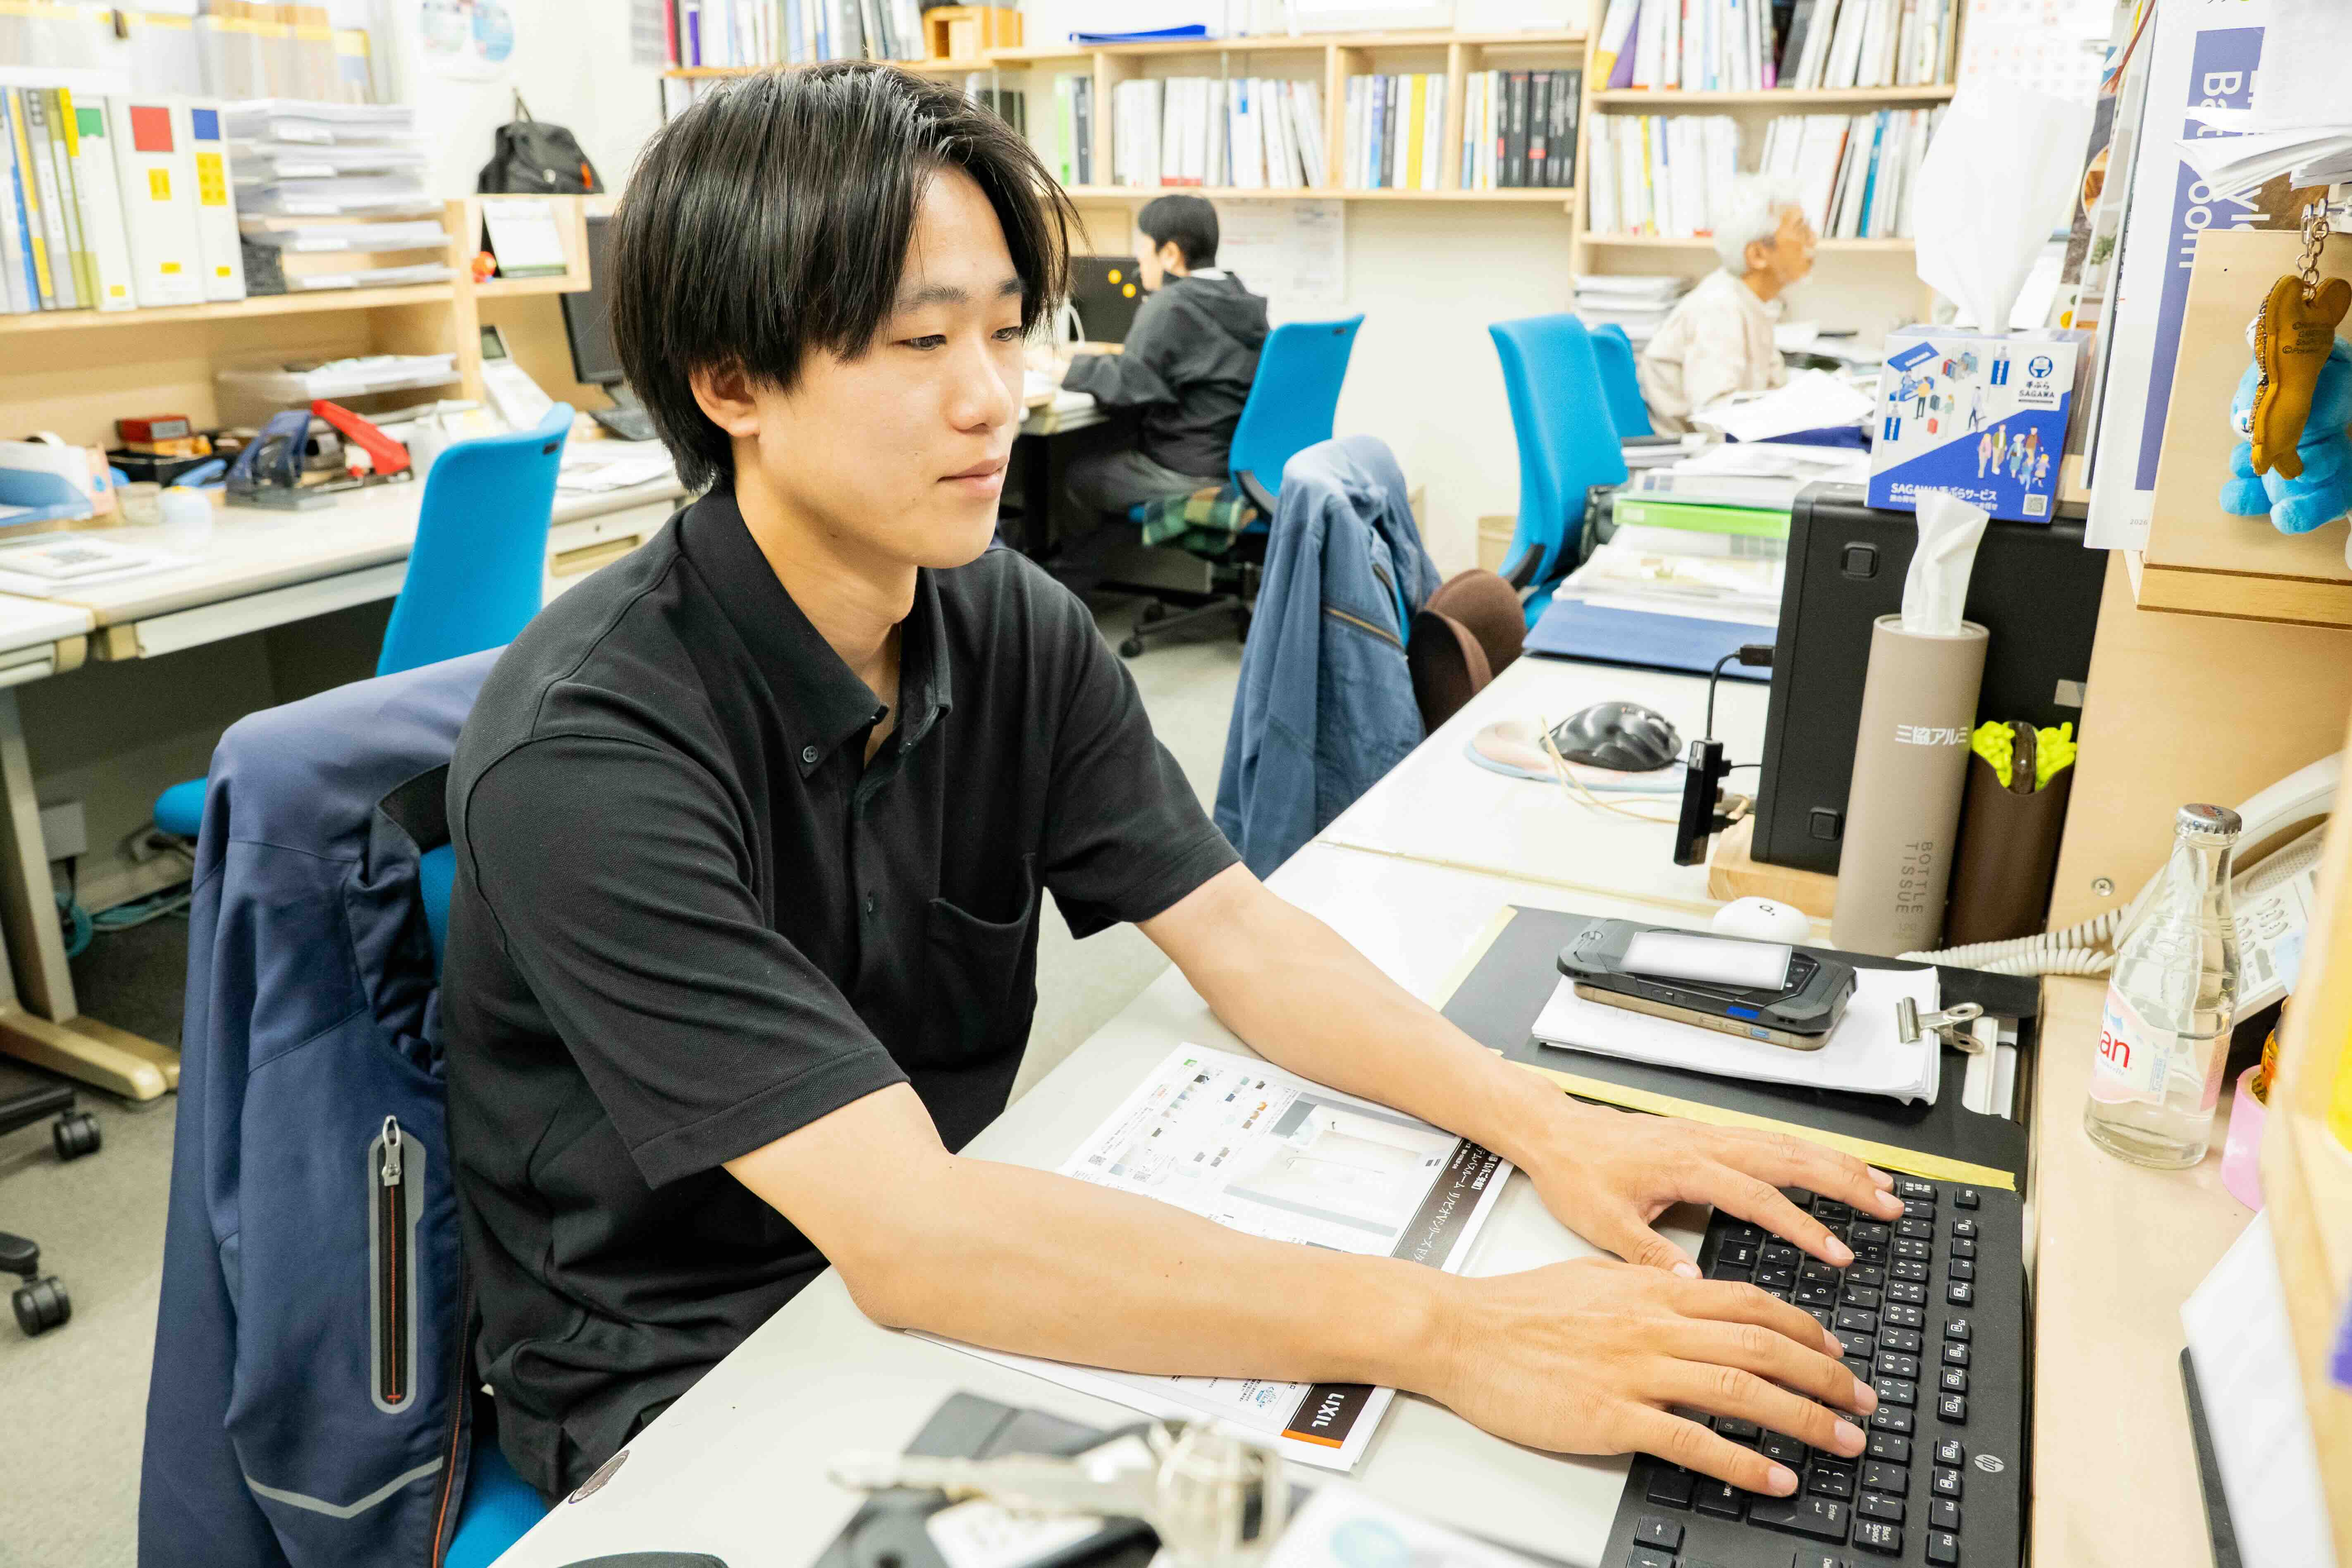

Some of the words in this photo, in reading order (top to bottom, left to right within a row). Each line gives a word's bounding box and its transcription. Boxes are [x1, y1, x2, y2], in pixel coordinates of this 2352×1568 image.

[2179, 71, 2242, 268] Batoom
[1895, 724, 1968, 745] 三協アルミ
[1896, 842, 1919, 913] TISSUE
[1911, 841, 1933, 914] BOTTLE
[1311, 1393, 1344, 1427] LIXIL
[1950, 1440, 1958, 1449] F9
[1974, 1454, 2005, 1473] hp
[1948, 1470, 1957, 1481] F10
[1827, 1504, 1837, 1521] Enter
[1945, 1501, 1954, 1511] F11
[1872, 1524, 1881, 1542] Space
[1881, 1525, 1891, 1541] Back
[1943, 1535, 1952, 1546] F12
